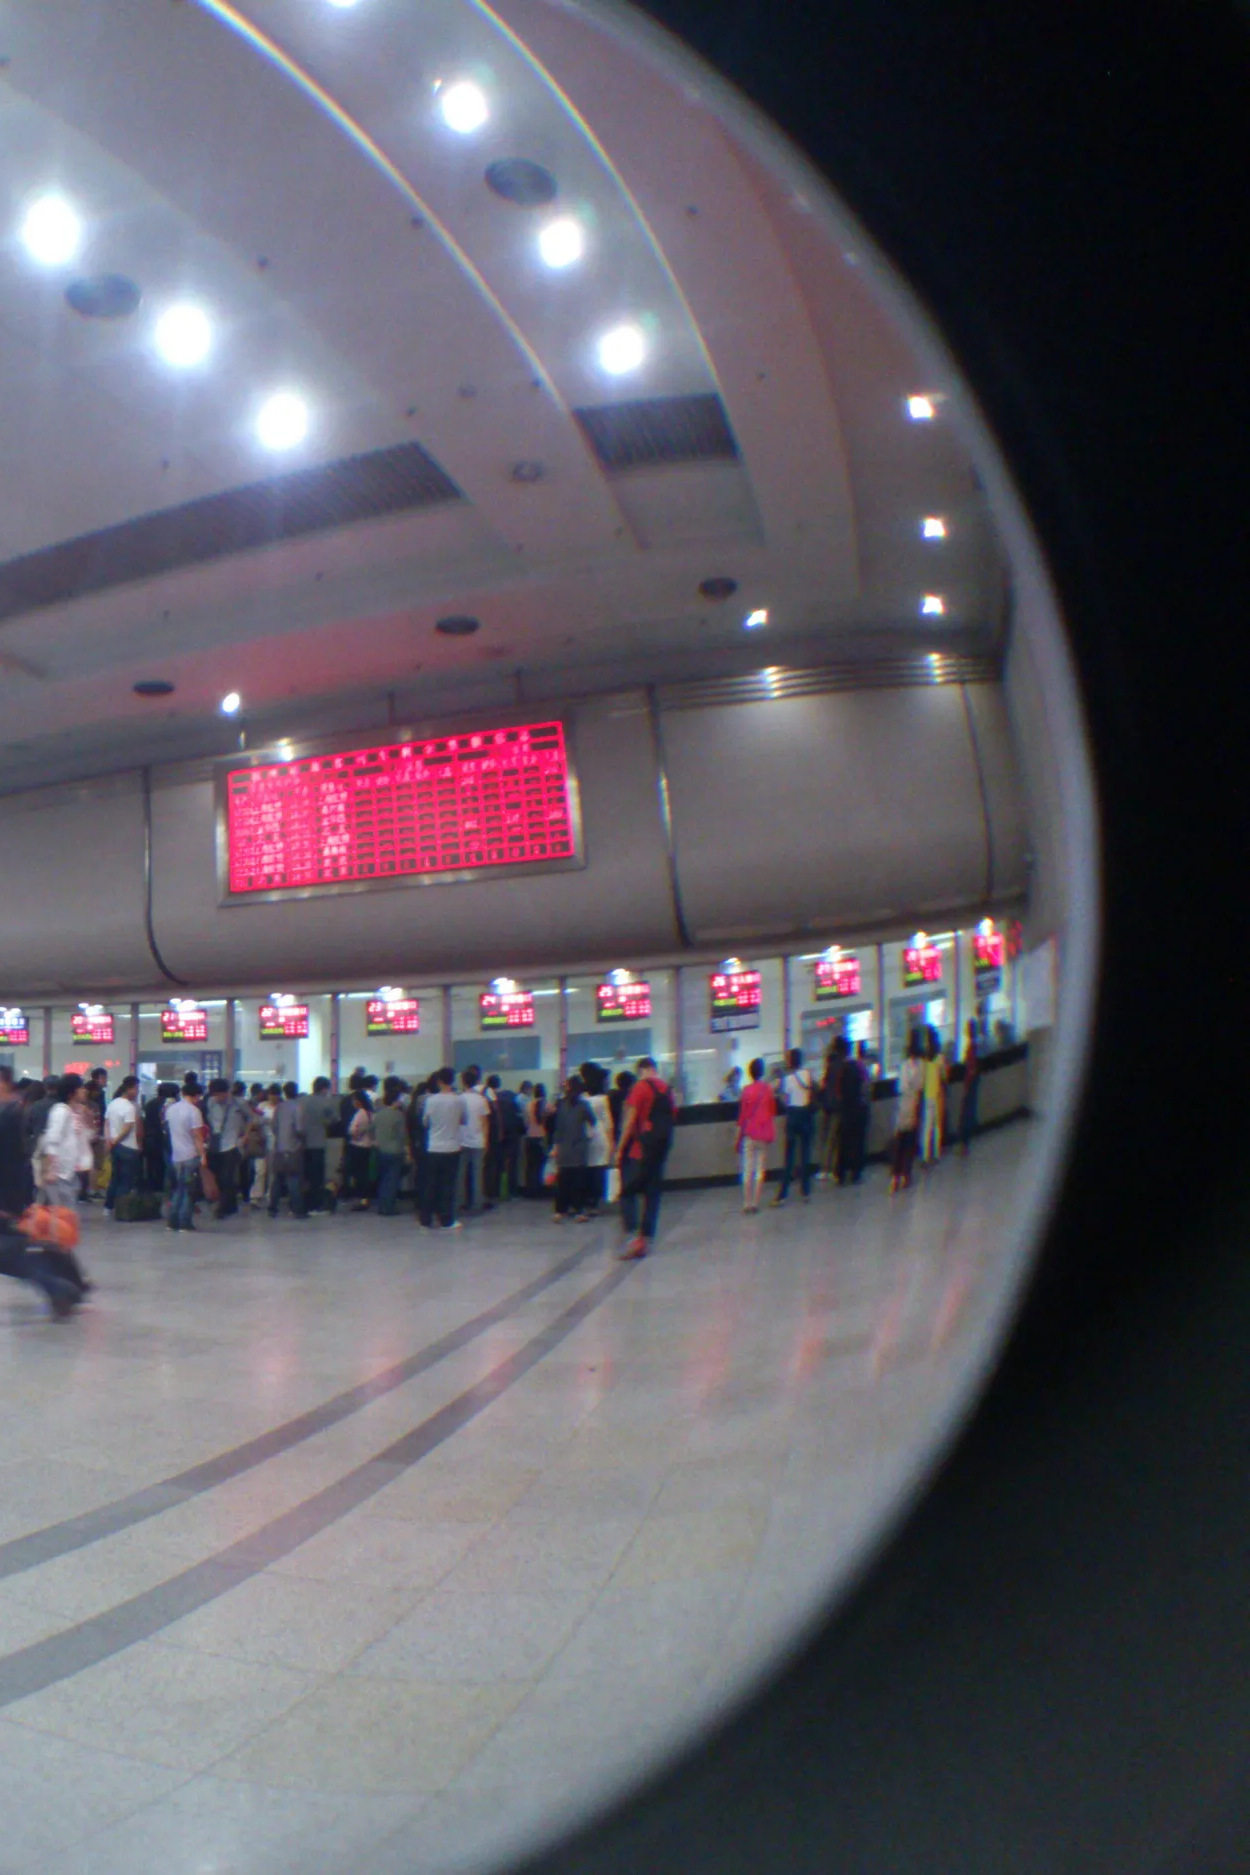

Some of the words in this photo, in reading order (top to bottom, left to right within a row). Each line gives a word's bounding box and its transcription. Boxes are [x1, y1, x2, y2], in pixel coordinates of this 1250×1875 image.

[599, 985, 612, 996] 25
[482, 995, 496, 1005] 24
[368, 1002, 381, 1012] 23
[163, 1012, 174, 1021] 21
